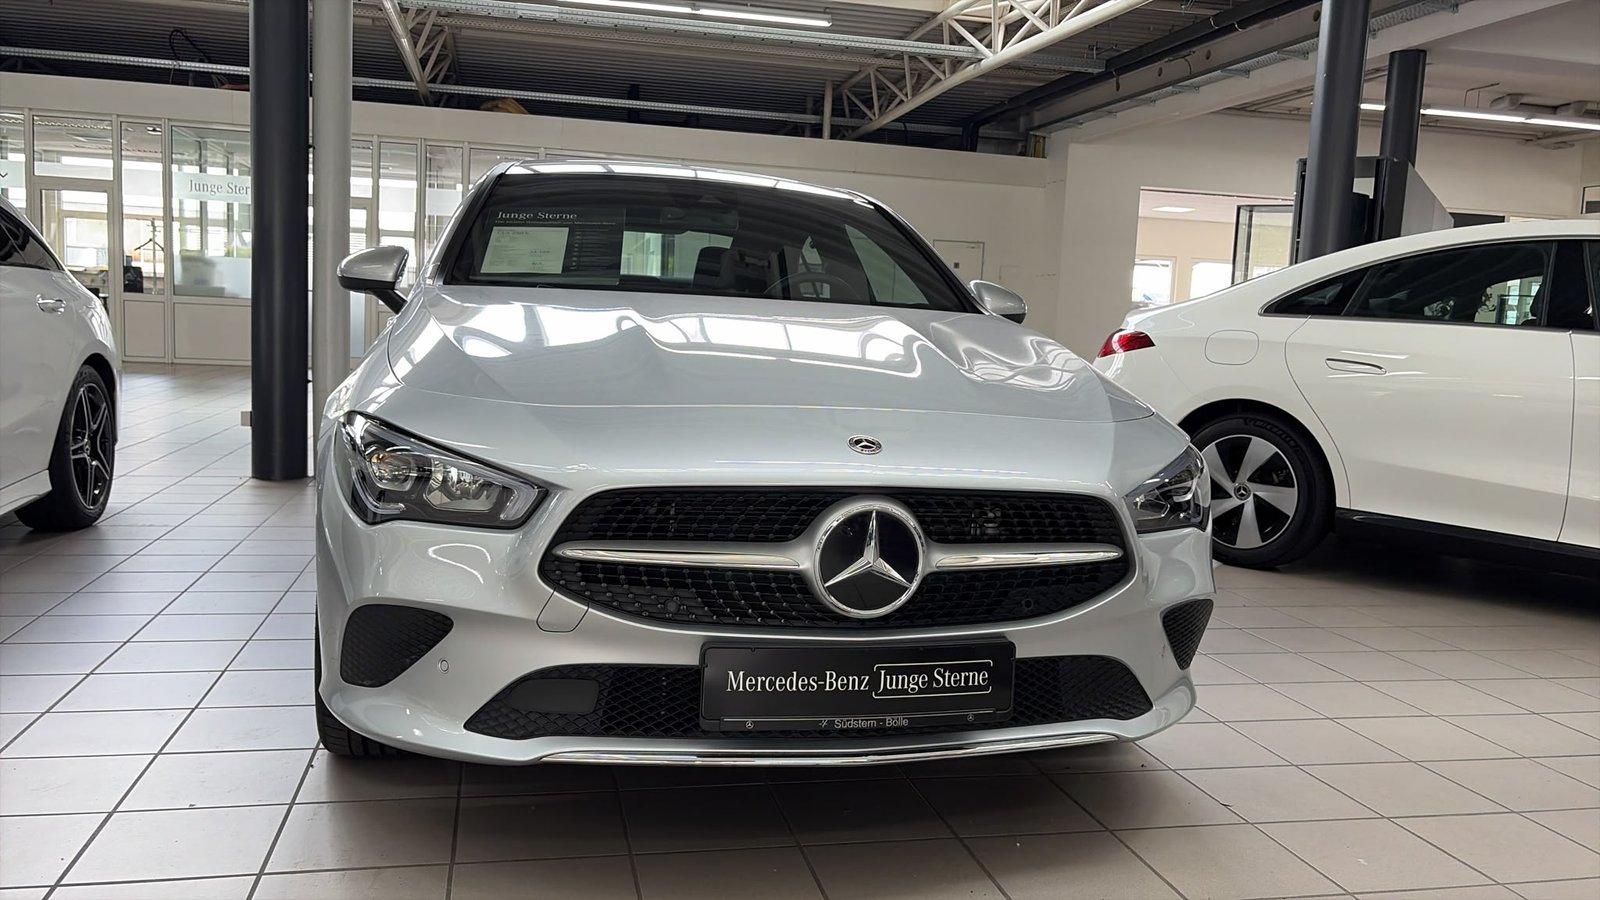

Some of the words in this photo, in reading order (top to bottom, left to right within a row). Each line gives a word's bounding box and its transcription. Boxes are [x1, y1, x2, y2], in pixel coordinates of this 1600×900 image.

[189, 179, 223, 196] Junge
[226, 182, 250, 195] Ster
[497, 211, 534, 220] Junge
[537, 211, 578, 220] Sterne
[726, 670, 870, 692] Mercedes-Benz
[878, 669, 928, 694] Junge
[932, 667, 989, 689] Sterne
[834, 718, 877, 729] Südstern
[885, 716, 909, 727] Bölle
